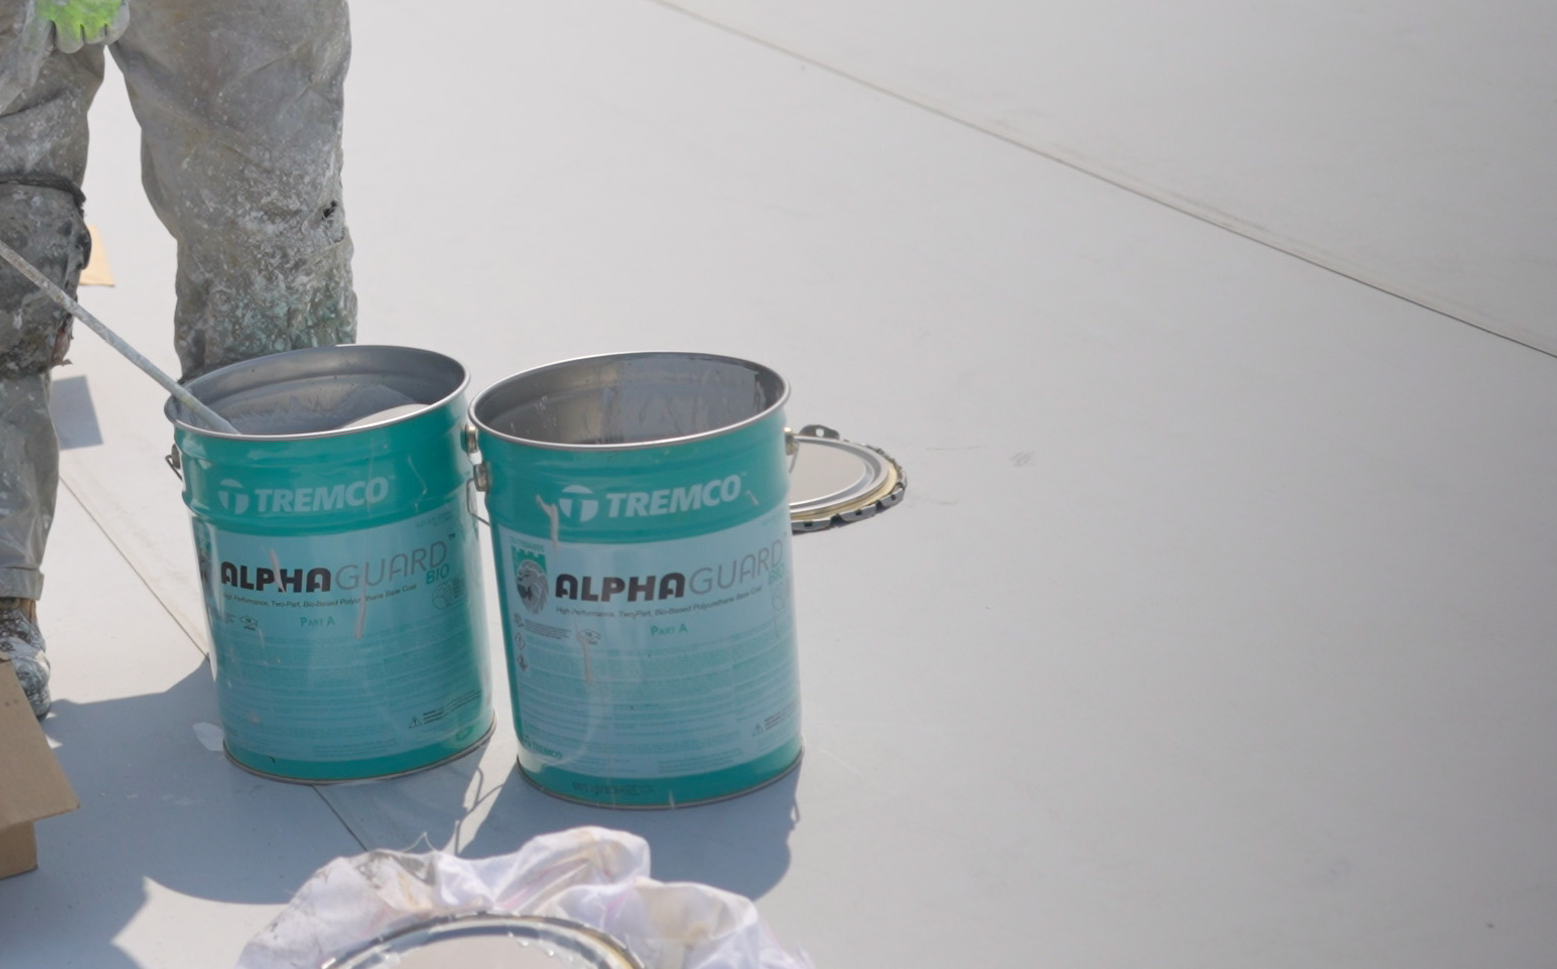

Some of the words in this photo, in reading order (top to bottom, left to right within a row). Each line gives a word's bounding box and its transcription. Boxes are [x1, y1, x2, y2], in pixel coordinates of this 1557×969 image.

[254, 477, 389, 516] TREMCO
[606, 474, 742, 520] TREMCO
[220, 541, 447, 593] ALPHAGUARD
[426, 563, 450, 585] BIO
[555, 538, 784, 602] ALPHAGUARD
[271, 600, 301, 608] Two-Part,
[303, 598, 339, 608] Bio-Based
[339, 592, 383, 607] Polyurthane
[385, 588, 401, 598] Base
[402, 583, 417, 593] Coat
[326, 615, 336, 626] A
[556, 606, 570, 616] High
[678, 622, 689, 633] A
